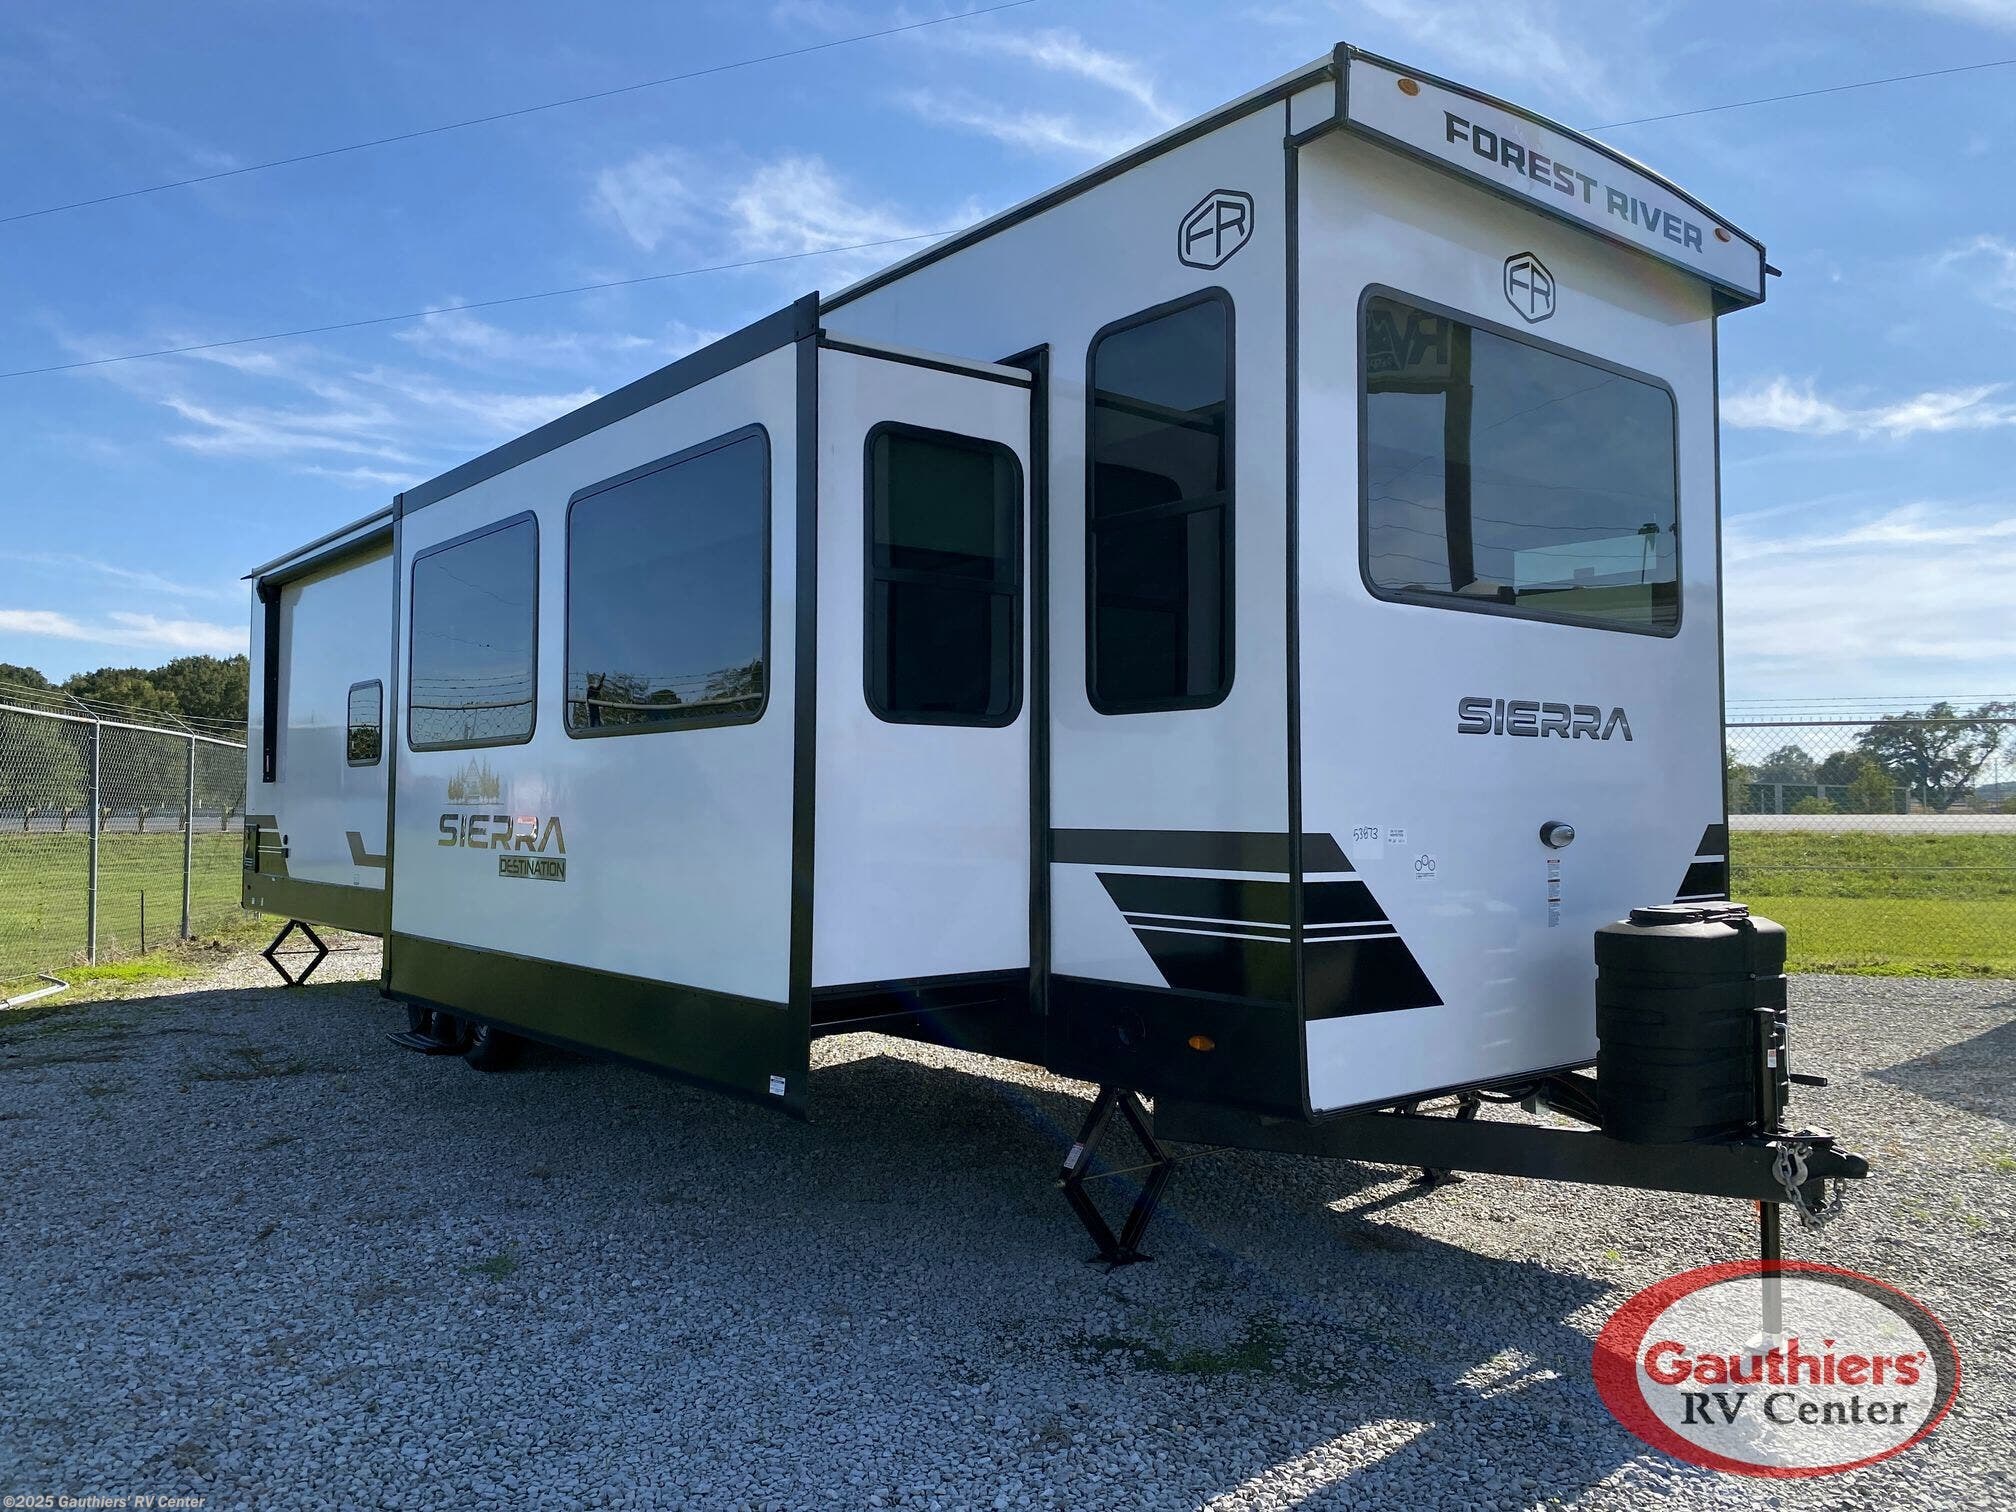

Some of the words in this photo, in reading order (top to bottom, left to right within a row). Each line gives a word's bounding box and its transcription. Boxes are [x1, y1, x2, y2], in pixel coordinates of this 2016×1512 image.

[1443, 110, 1598, 205] FOREST
[1605, 184, 1704, 254] RIVER
[1457, 696, 1633, 742] SIERRA
[438, 813, 567, 854] SIERRA
[500, 858, 565, 880] DESTINATION
